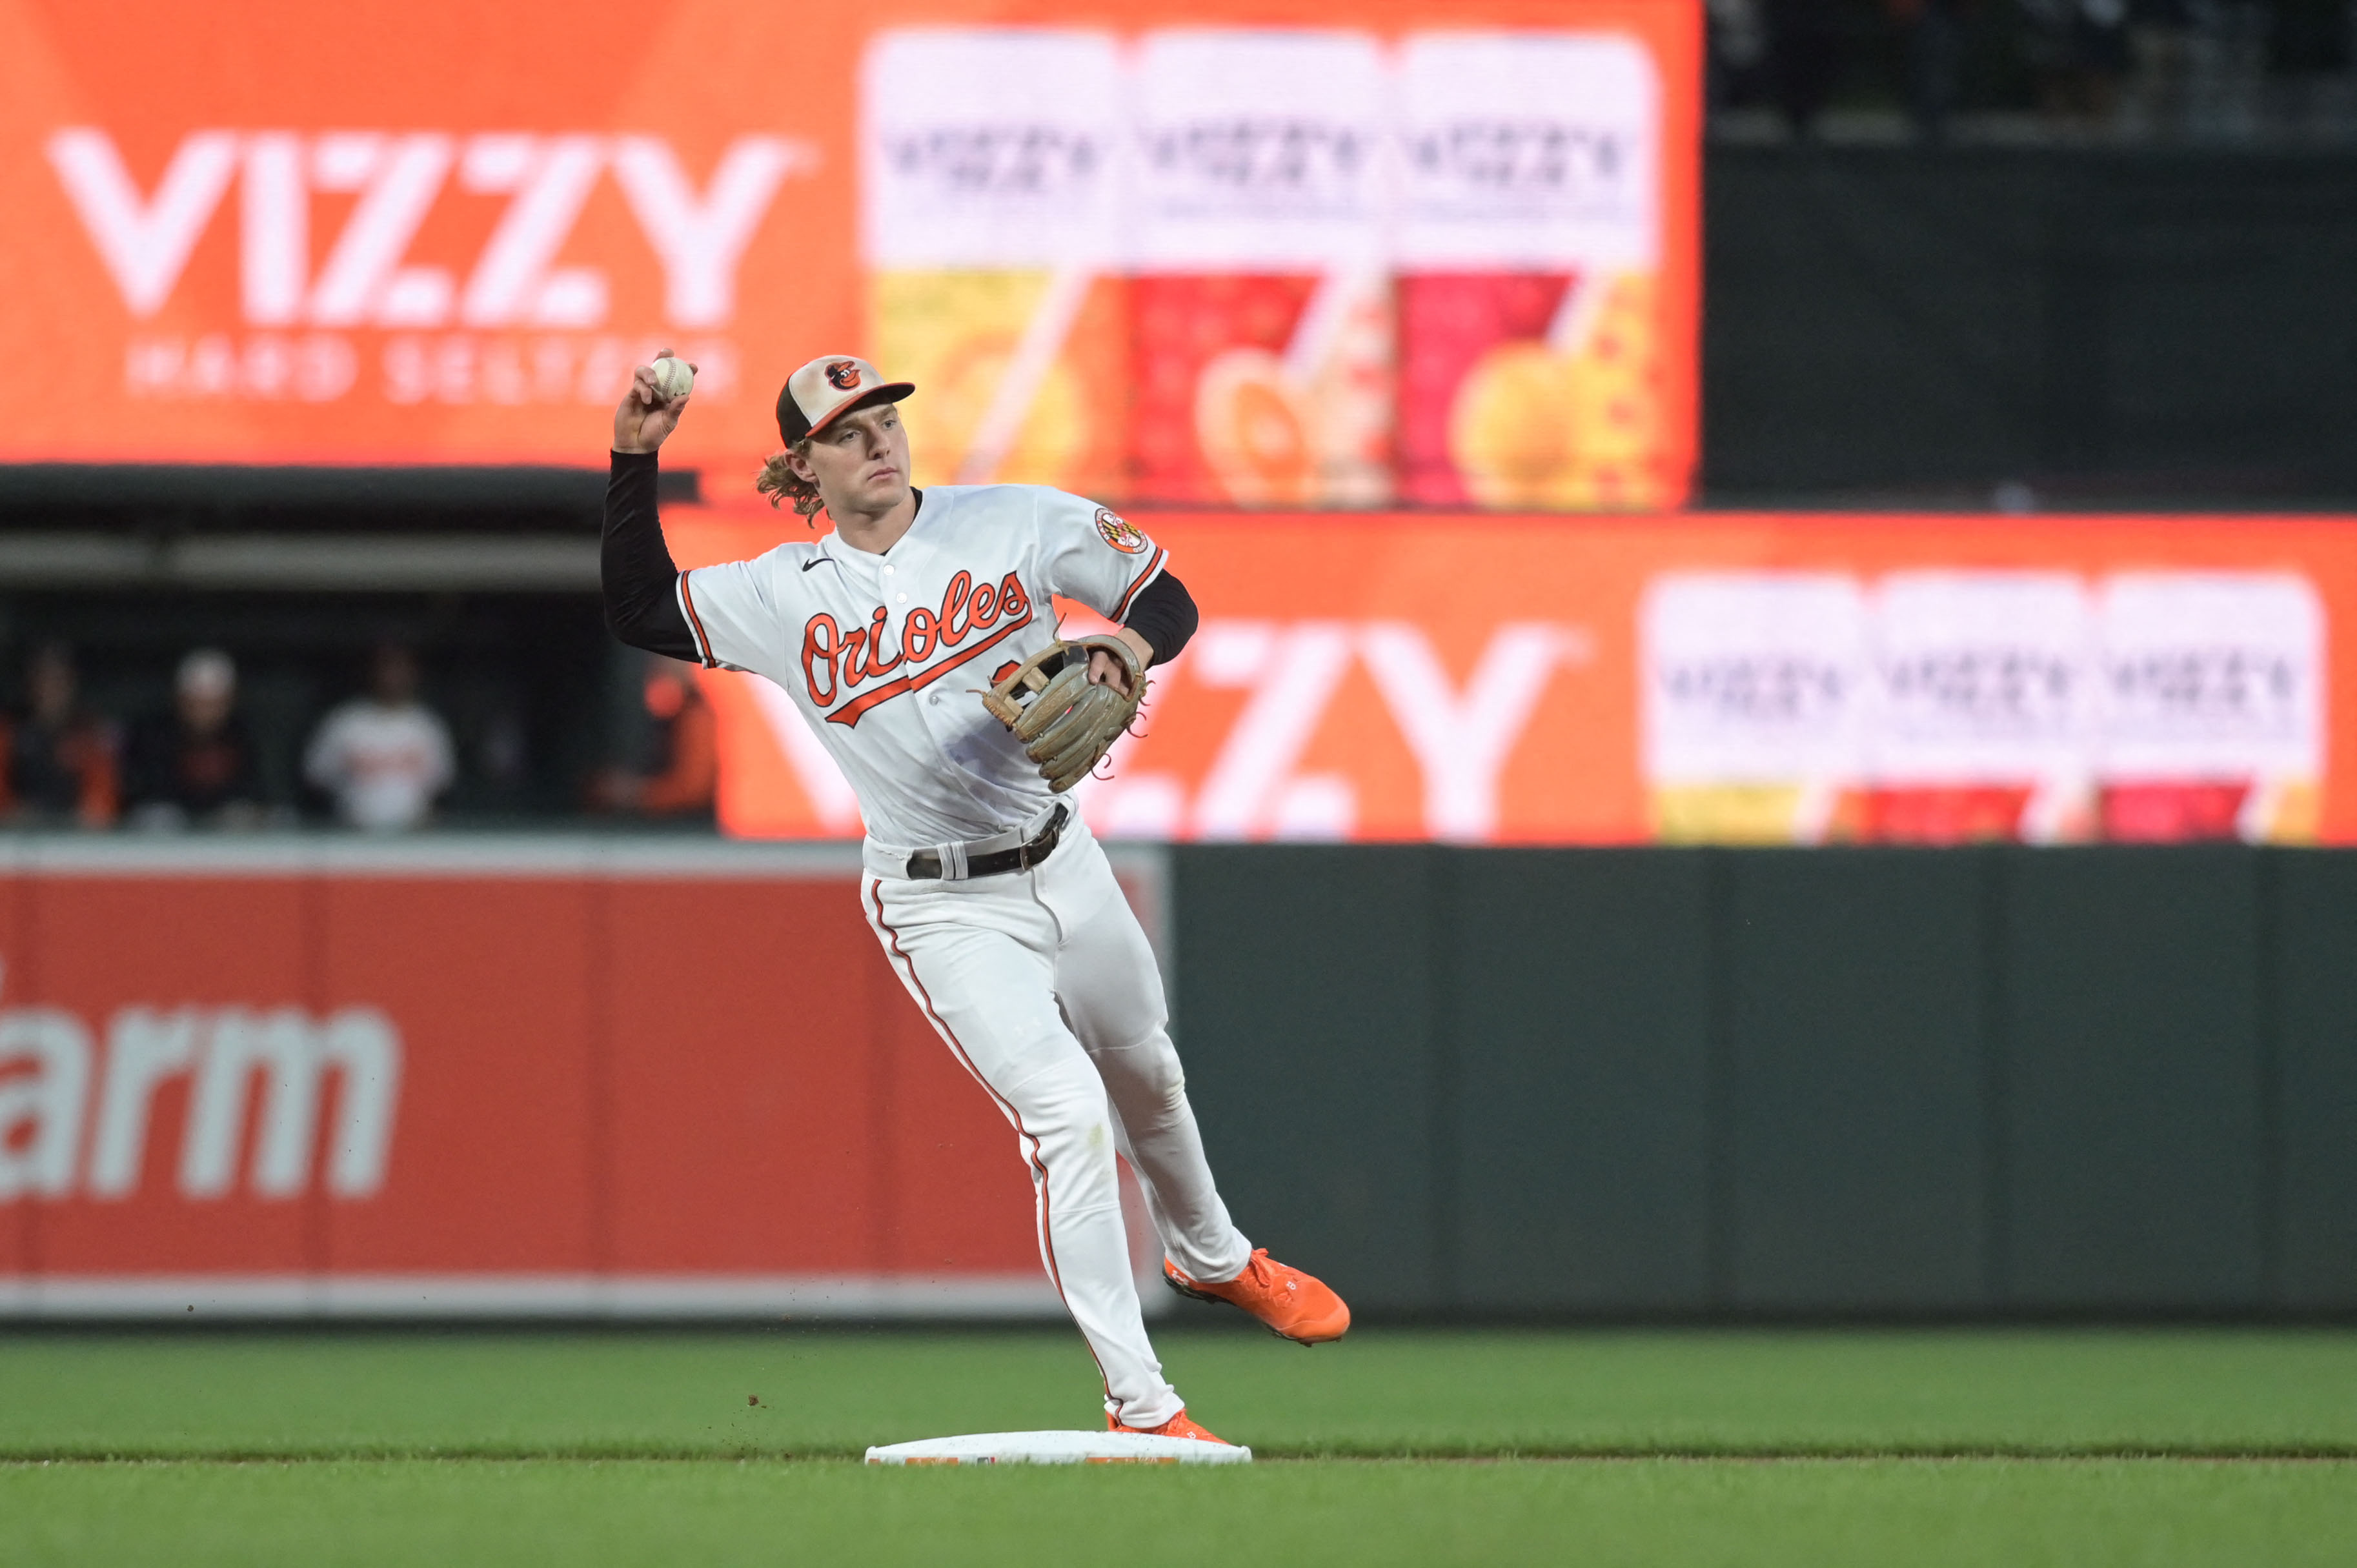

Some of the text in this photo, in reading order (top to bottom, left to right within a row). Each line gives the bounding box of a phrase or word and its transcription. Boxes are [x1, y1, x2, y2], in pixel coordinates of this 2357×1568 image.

[49, 130, 789, 325] VIZZY
[802, 570, 1033, 708] Orioles
[0, 1004, 401, 1200] arm
